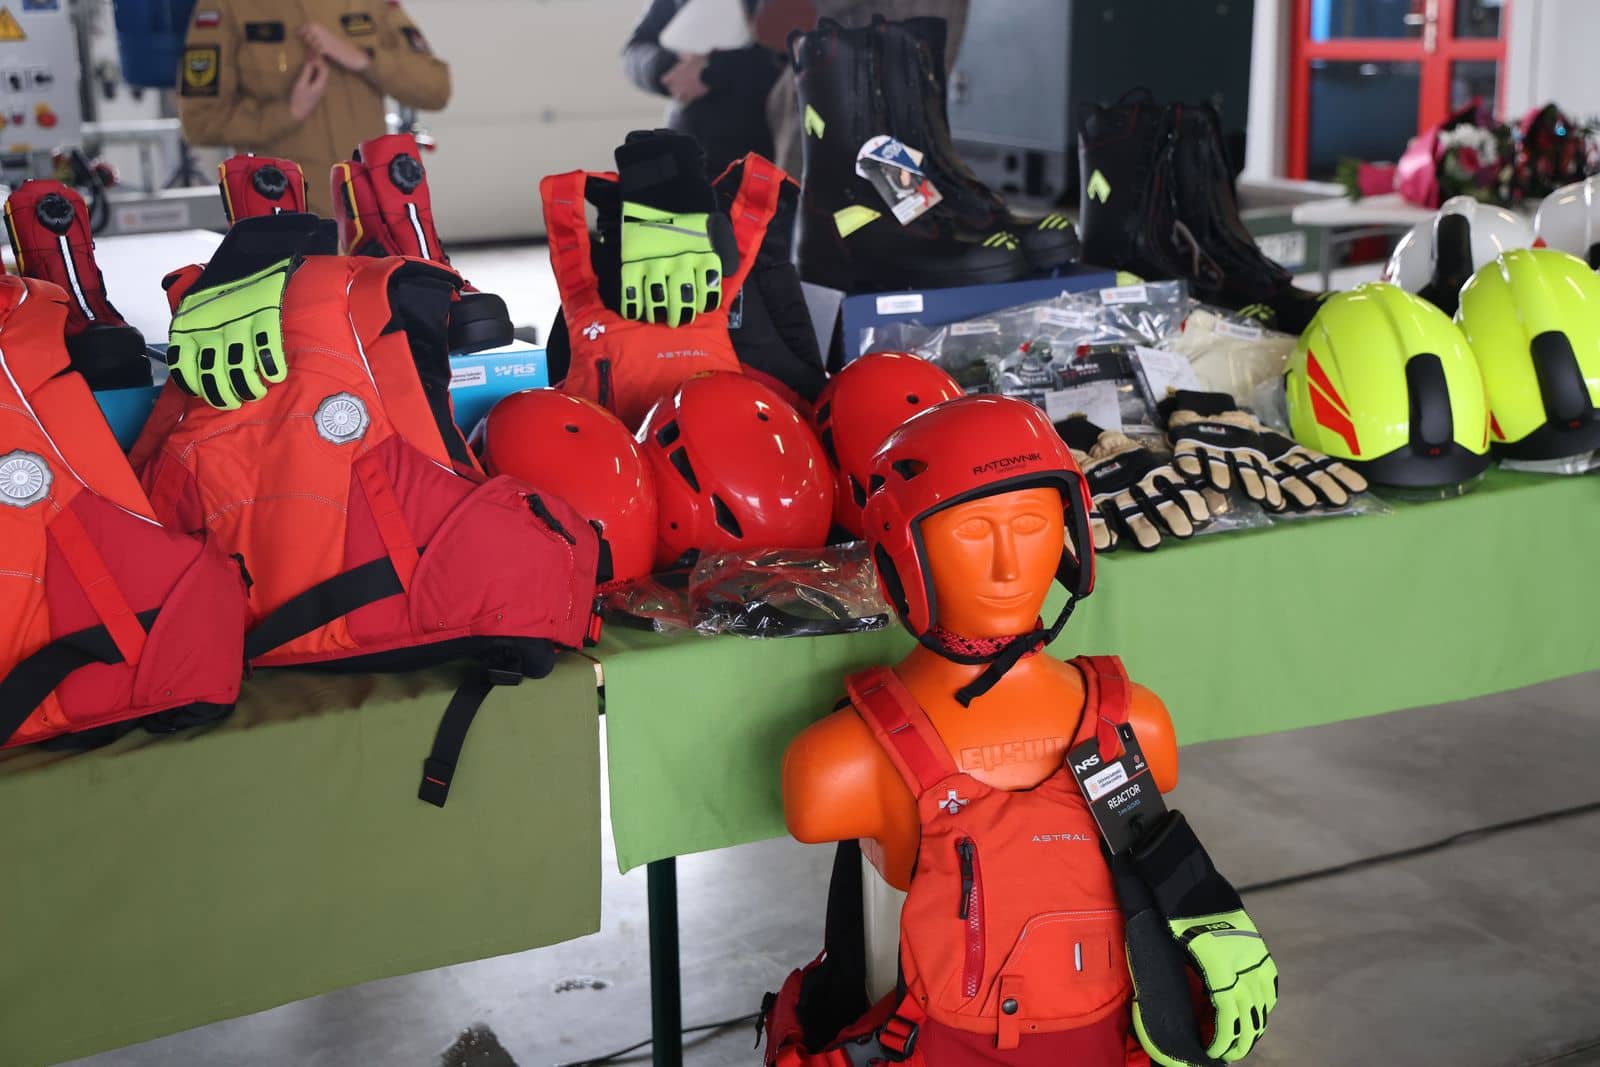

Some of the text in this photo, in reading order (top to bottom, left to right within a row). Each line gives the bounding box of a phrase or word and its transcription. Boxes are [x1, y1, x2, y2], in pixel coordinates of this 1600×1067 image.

[656, 349, 708, 359] ASTRAL
[972, 452, 1042, 476] RATOWNIK
[1074, 753, 1100, 774] NRS
[1106, 783, 1141, 810] REACTOR
[1031, 833, 1091, 843] ASTRAL
